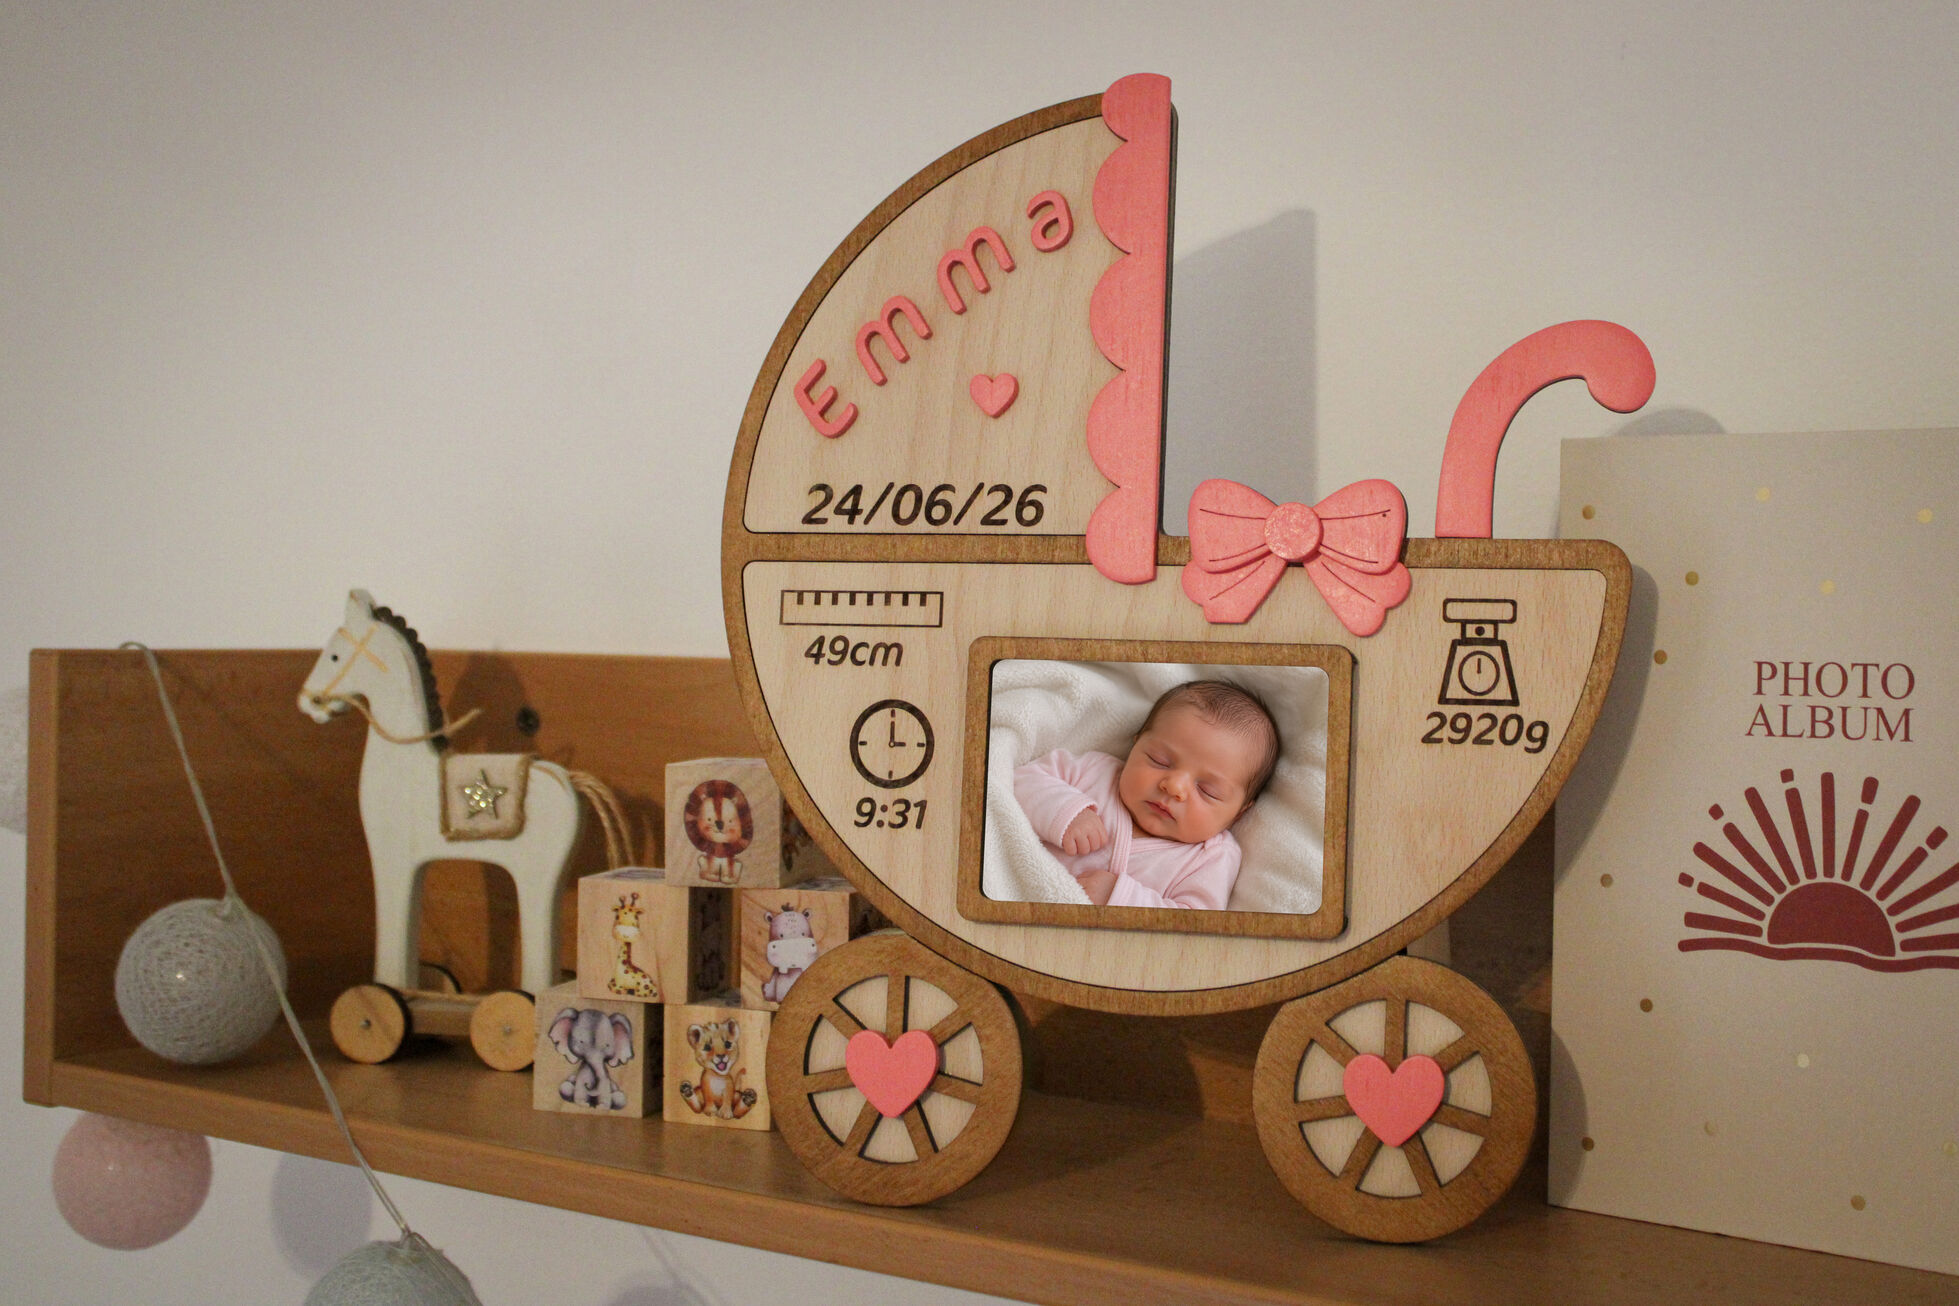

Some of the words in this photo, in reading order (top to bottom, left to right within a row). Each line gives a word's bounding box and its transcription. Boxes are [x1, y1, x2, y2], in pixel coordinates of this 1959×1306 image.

[793, 189, 1075, 440] Emma
[801, 481, 1048, 528] 24/06/26
[804, 634, 904, 668] 49cm
[1752, 660, 1915, 700] PHOTO
[1420, 710, 1550, 754] 2920g
[1744, 703, 1915, 743] ALBUM
[853, 796, 928, 830] 9:31
